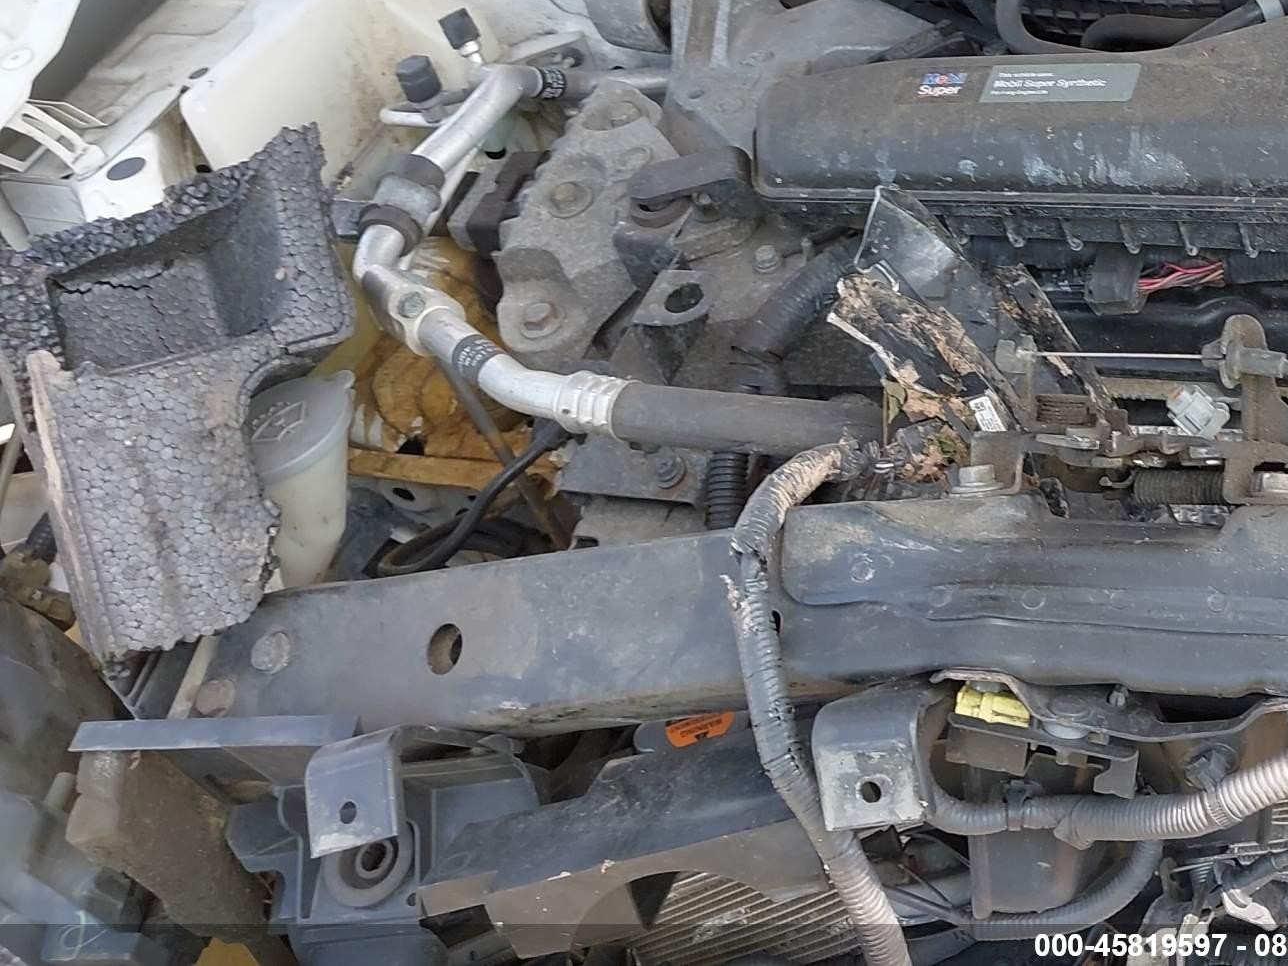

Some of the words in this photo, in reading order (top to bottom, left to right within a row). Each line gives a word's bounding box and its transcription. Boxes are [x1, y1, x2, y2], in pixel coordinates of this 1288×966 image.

[993, 80, 1023, 88] Mobil
[1023, 79, 1055, 89] Super
[917, 84, 962, 97] Super
